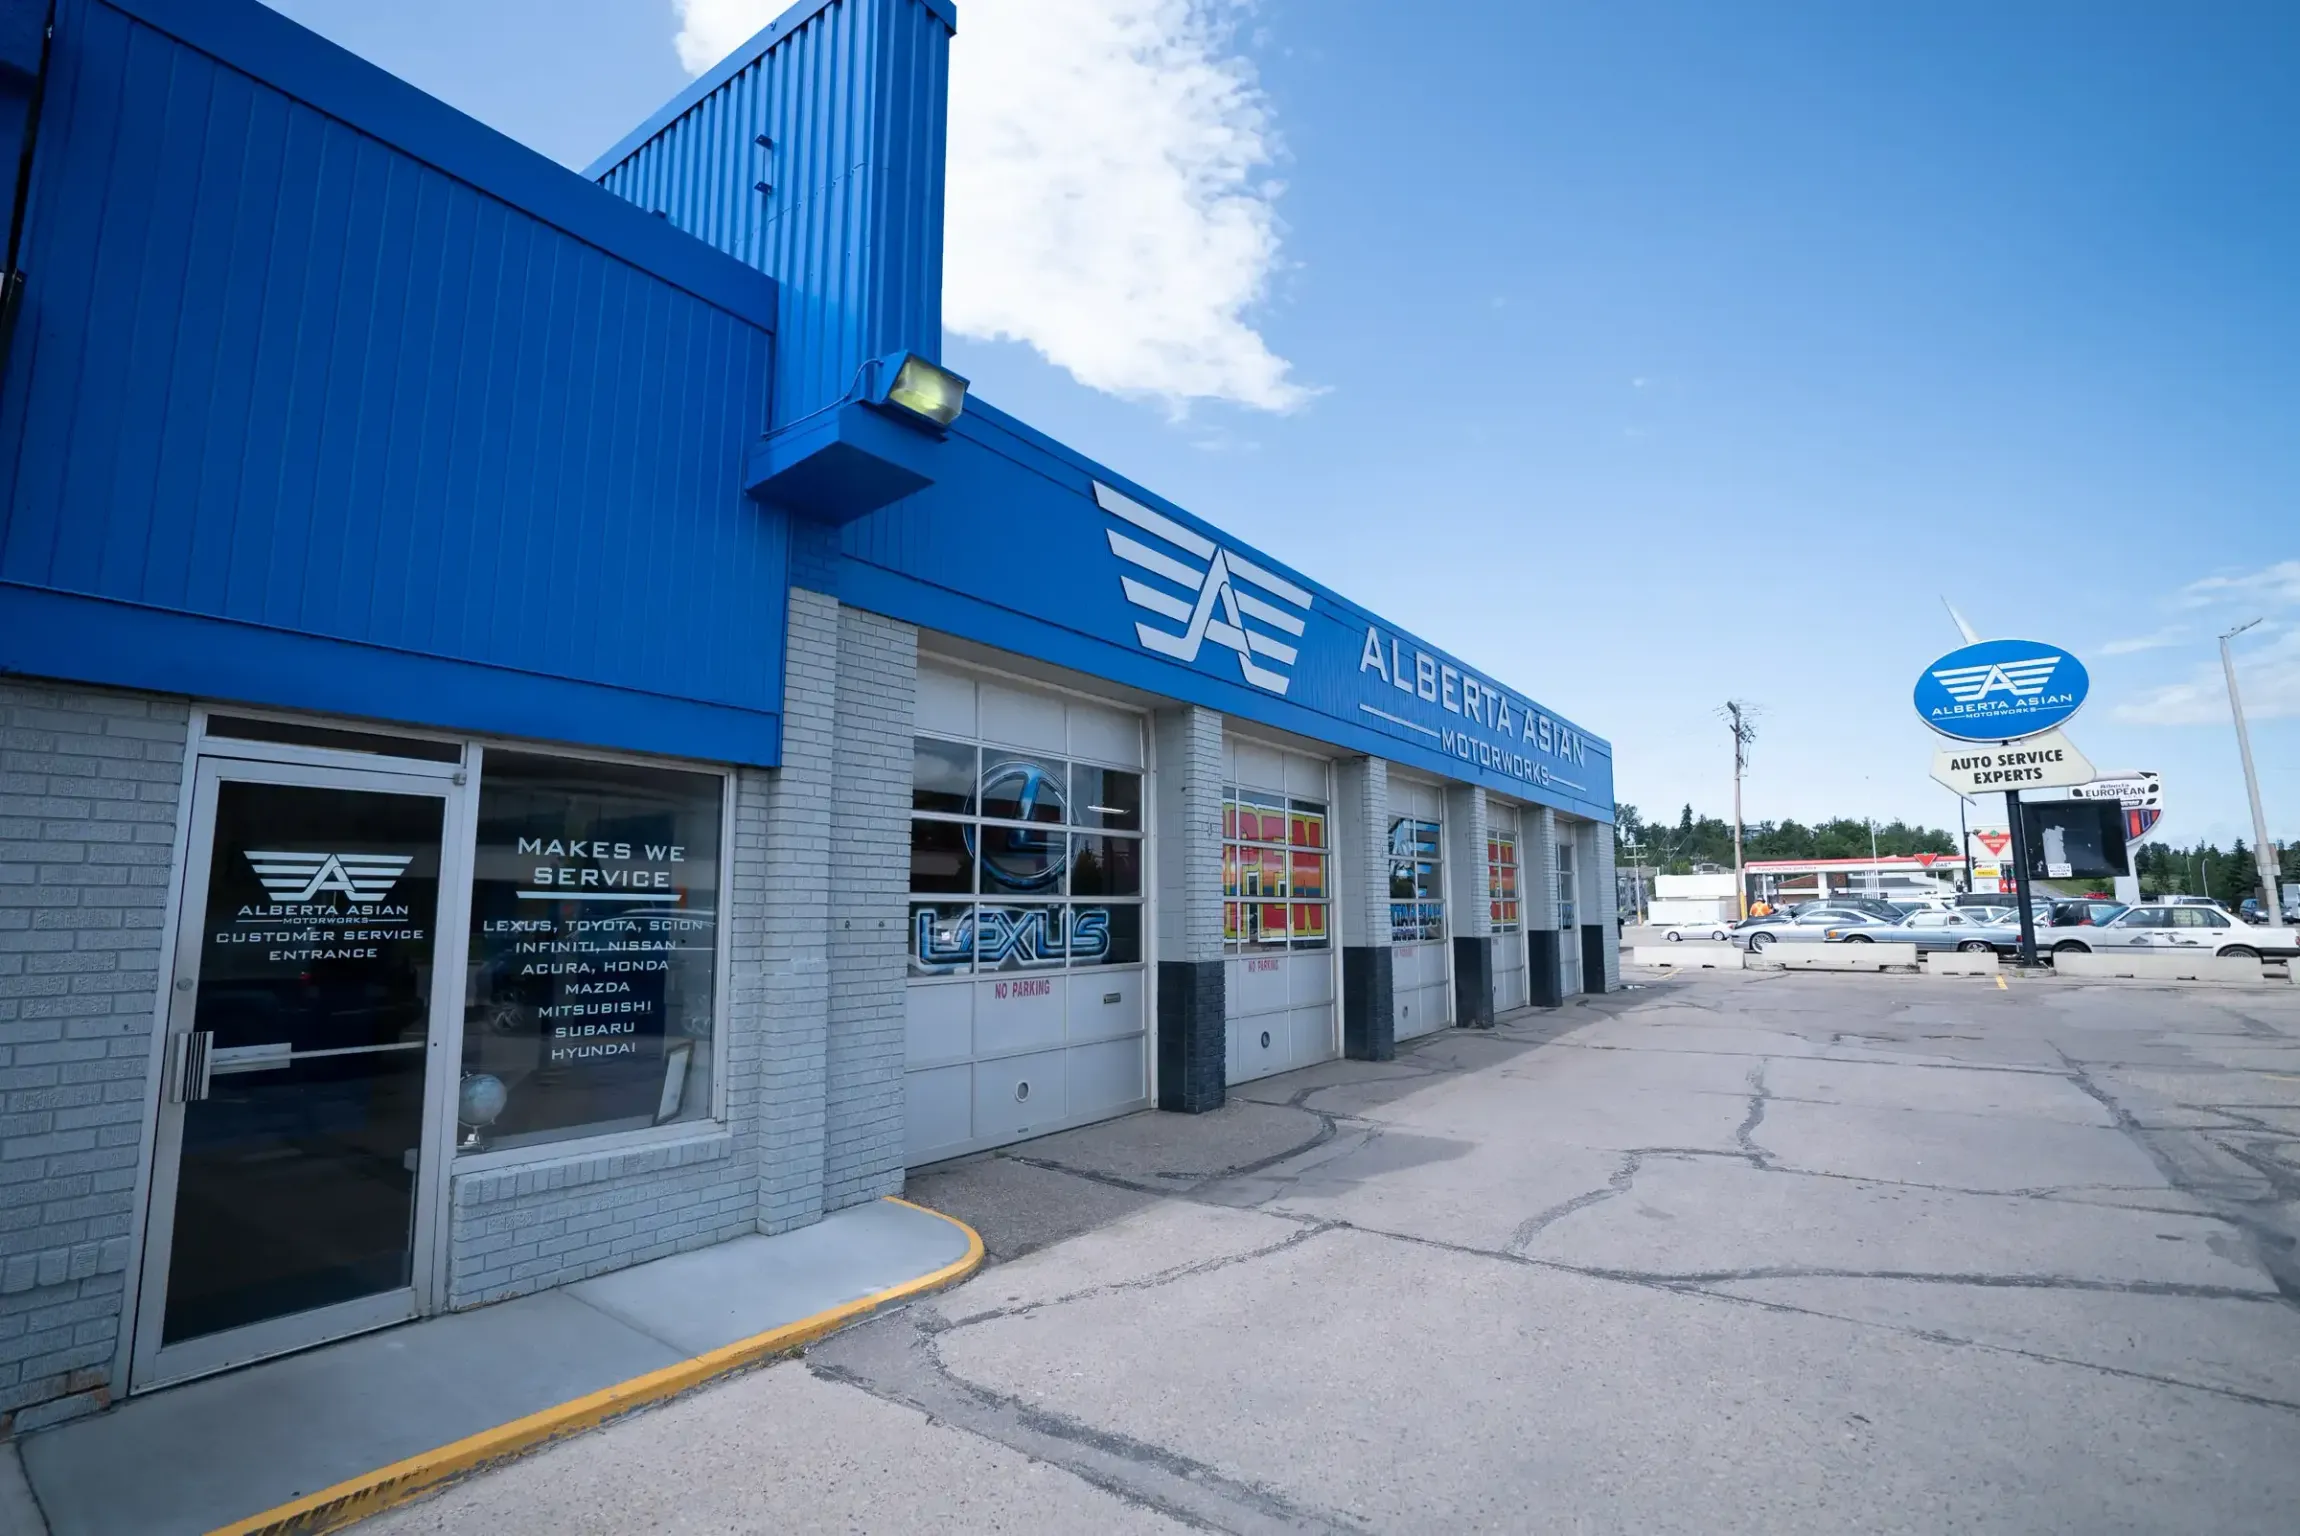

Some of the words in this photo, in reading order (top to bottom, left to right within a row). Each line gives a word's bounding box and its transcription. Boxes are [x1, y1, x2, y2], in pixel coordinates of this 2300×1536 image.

[1359, 626, 1513, 738] ALBERTA
[1522, 709, 1585, 768] ASIAN
[1932, 700, 2009, 716] ALBERTA
[2015, 693, 2072, 706] ASIAN
[1966, 707, 2037, 719] MOTORWORKS
[1441, 727, 1550, 786] MOTORWORKS
[1951, 756, 1992, 771] AUTO
[1997, 749, 2063, 767] SERVICE
[1974, 768, 2043, 784] EXPERTS
[2086, 787, 2145, 797] EUROPEAN
[518, 837, 631, 860] MAKES
[644, 844, 685, 862] WE
[534, 867, 670, 887] SERVICE
[237, 905, 337, 916] ALBERTA
[347, 905, 409, 915] ASIAN
[483, 920, 558, 933] LEXUS,
[566, 921, 642, 933] TOYOTA,
[649, 921, 703, 931] SCION
[216, 931, 335, 942] CUSTOMER
[344, 929, 423, 940] SERVICE
[916, 908, 1110, 969] LEXUS
[269, 948, 378, 960] ENTRANCE
[516, 941, 600, 954] INFINITI,
[608, 940, 676, 951] NISSAN
[521, 963, 595, 975] ACURA,
[604, 960, 669, 972] HONDA
[1248, 960, 1256, 973] NO
[1257, 960, 1279, 972] PARKING
[565, 983, 630, 995] MAZDA
[995, 983, 1008, 999] NO
[1012, 980, 1051, 997] PARKING
[538, 1001, 651, 1018] MITSUBISHI
[555, 1022, 635, 1038] SUBARU
[551, 1042, 636, 1060] HYUNDAI
